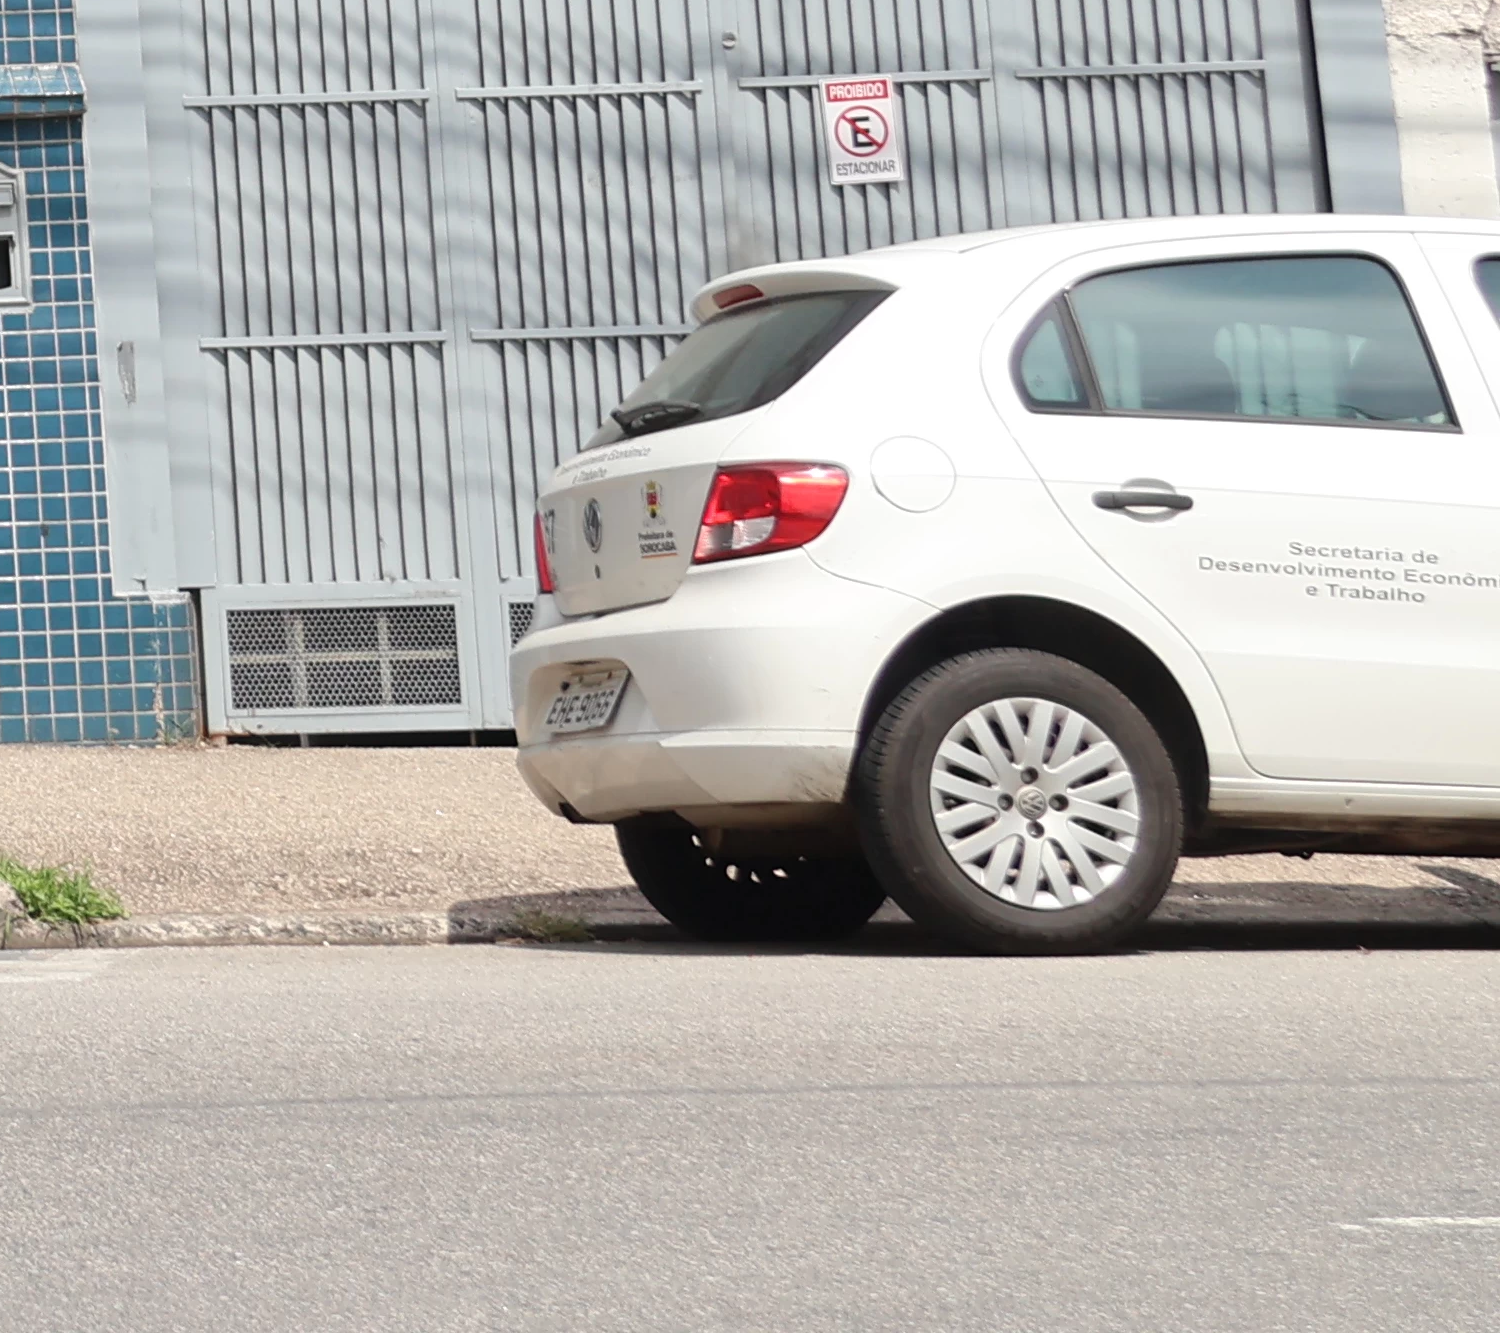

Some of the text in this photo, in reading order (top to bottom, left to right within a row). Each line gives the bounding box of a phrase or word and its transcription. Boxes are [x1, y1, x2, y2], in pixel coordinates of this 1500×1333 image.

[829, 82, 885, 100] PROIBIDO
[850, 116, 874, 148] E
[836, 159, 897, 176] ESTACIONAR
[639, 540, 677, 554] SOROCABA
[1288, 541, 1440, 565] Secretaria de
[1198, 556, 1396, 582] Desenvolvimento
[1305, 583, 1427, 604] e Trabalho
